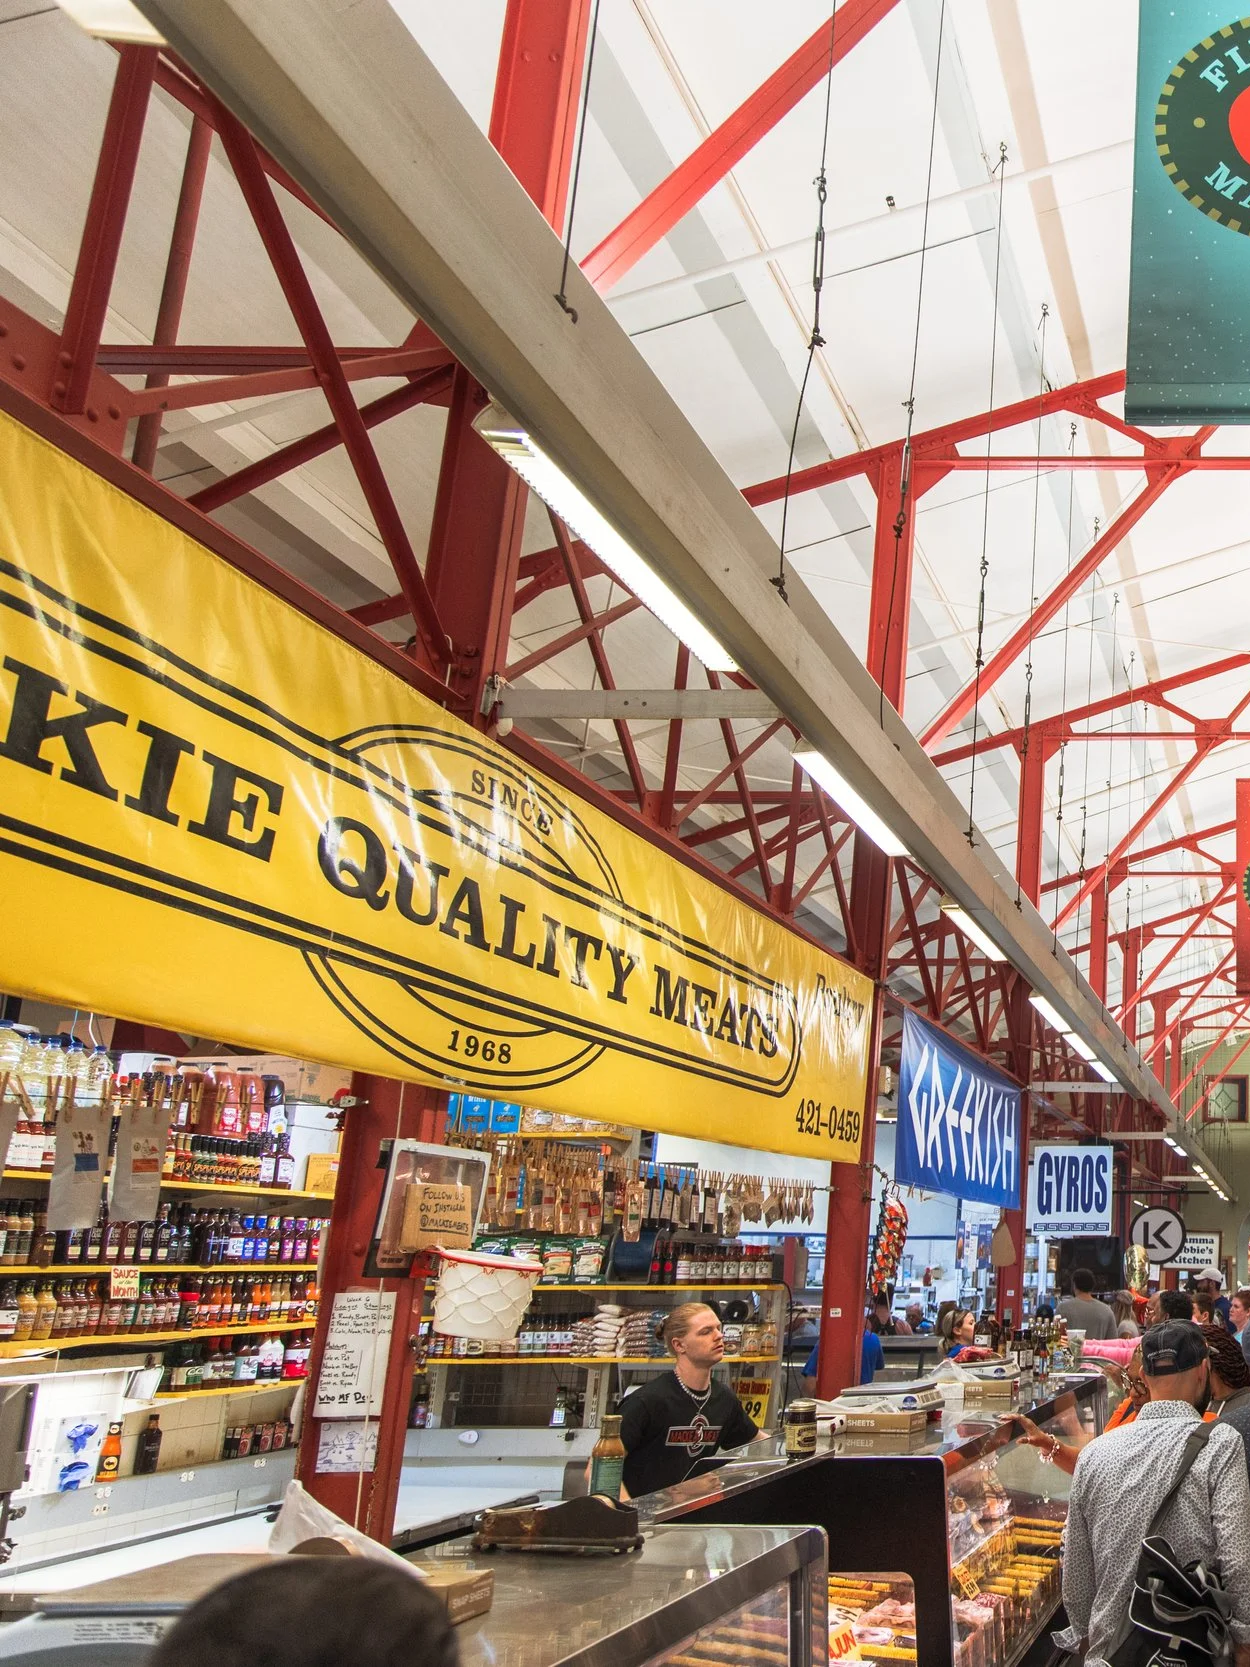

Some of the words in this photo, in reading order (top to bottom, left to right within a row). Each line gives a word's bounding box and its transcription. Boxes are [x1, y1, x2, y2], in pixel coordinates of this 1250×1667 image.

[471, 769, 553, 836] SINCE
[317, 816, 640, 1004] QUALITY
[650, 966, 779, 1058] MEATS
[447, 1029, 512, 1064] 1968
[796, 1098, 860, 1145] 421-0459
[908, 1043, 1016, 1192] GREEKISH
[423, 1188, 453, 1200] FOLLOW
[1038, 1151, 1108, 1216] GYROS
[419, 1203, 432, 1212] ON
[113, 1268, 139, 1278] SAUCE
[112, 1286, 138, 1297] MONTH
[846, 1419, 876, 1427] SHEETS
